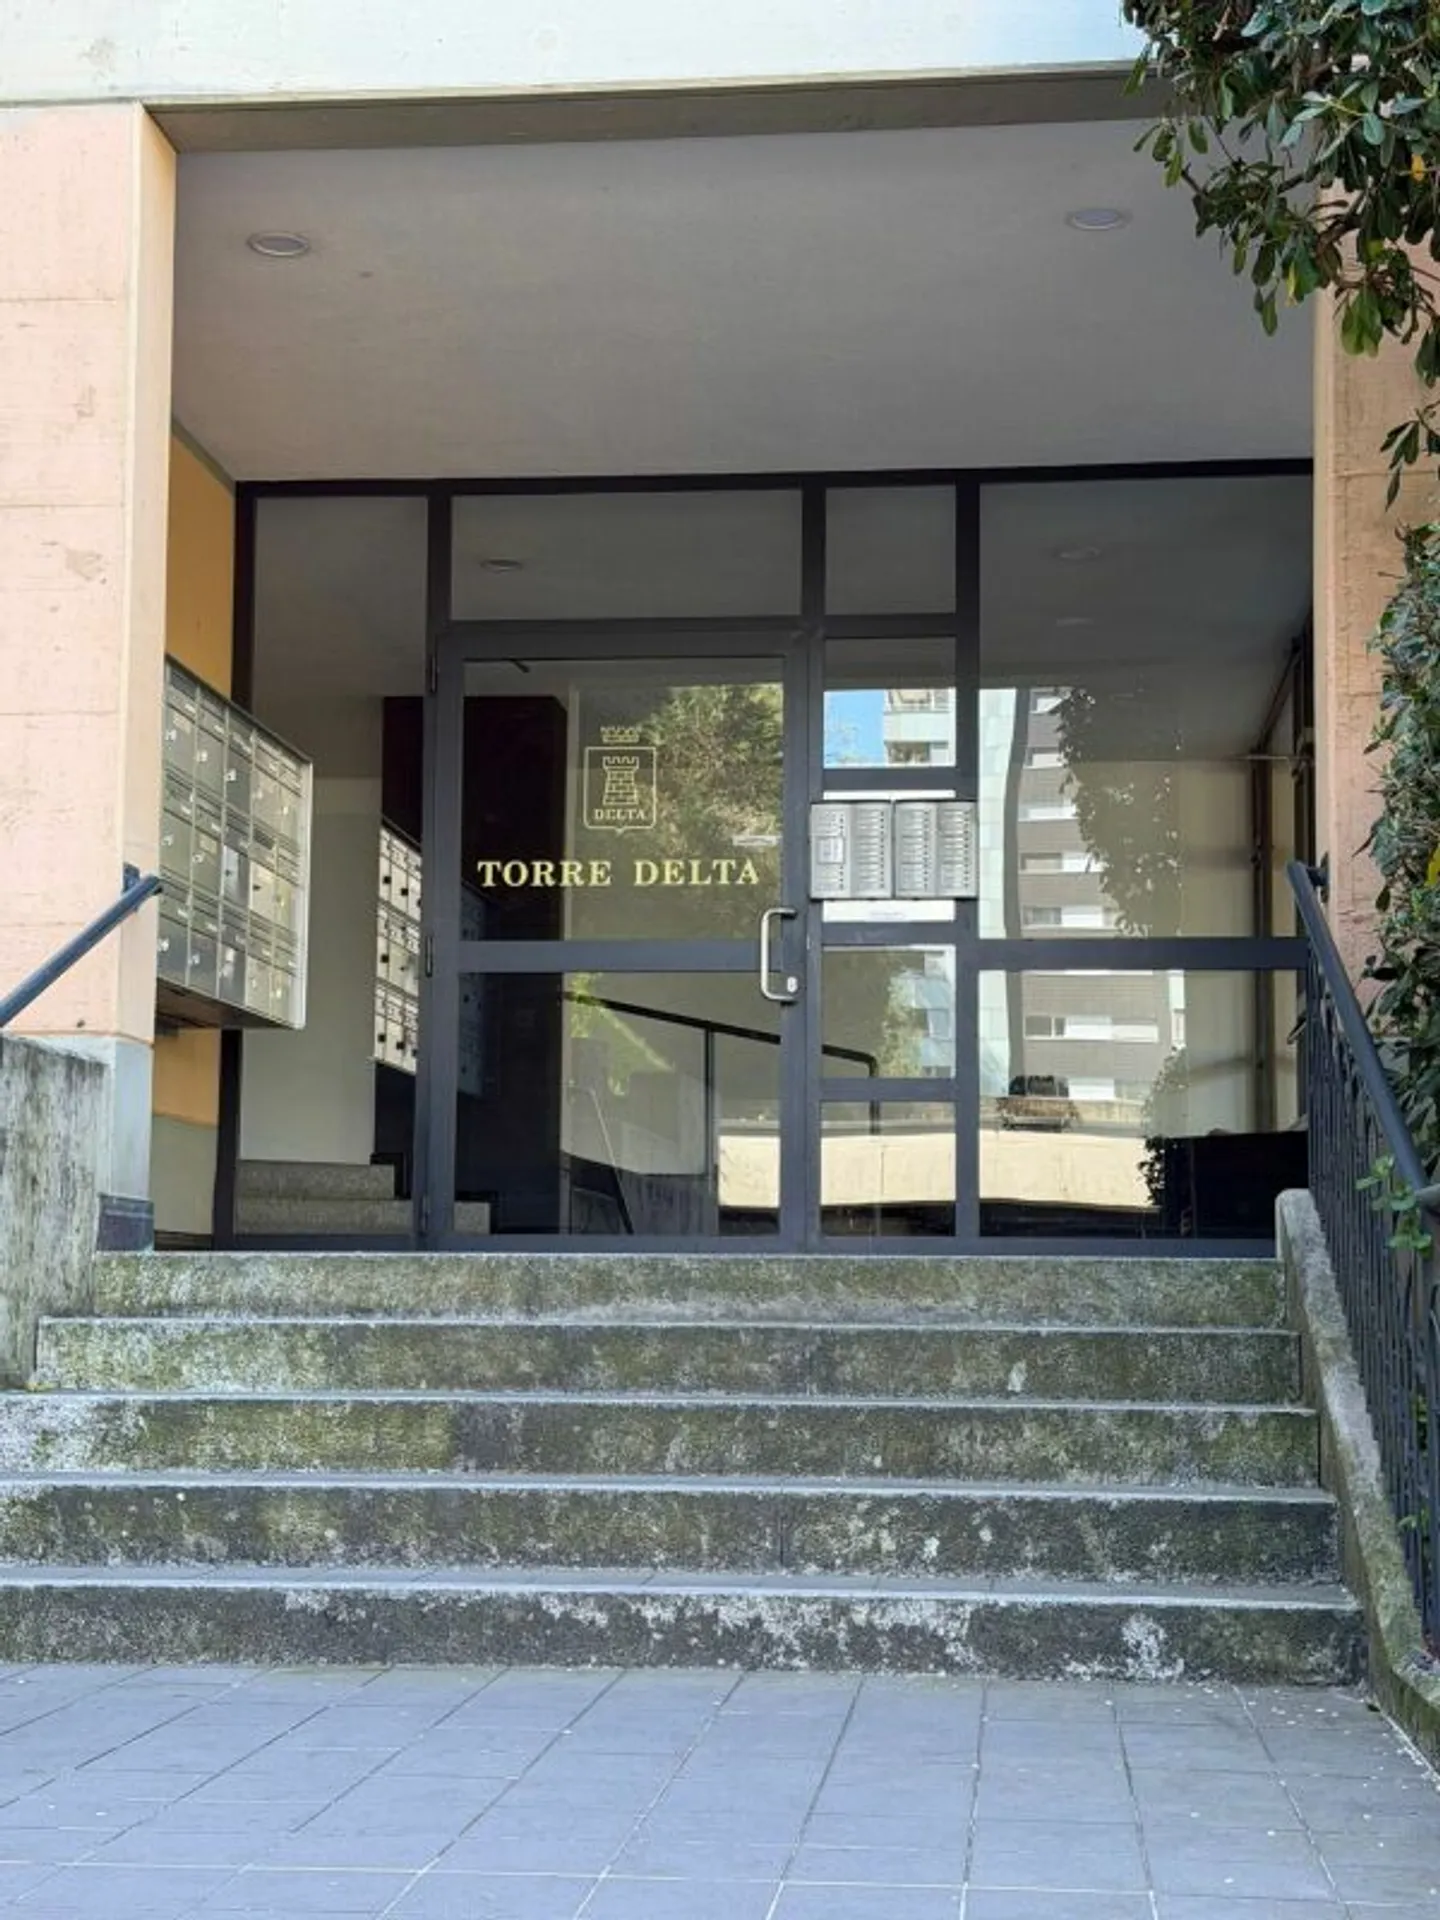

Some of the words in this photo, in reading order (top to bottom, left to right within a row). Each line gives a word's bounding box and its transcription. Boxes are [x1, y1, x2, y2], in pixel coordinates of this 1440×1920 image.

[594, 809, 646, 821] DELTA
[478, 860, 612, 886] TORRE
[634, 859, 760, 886] DELTA
